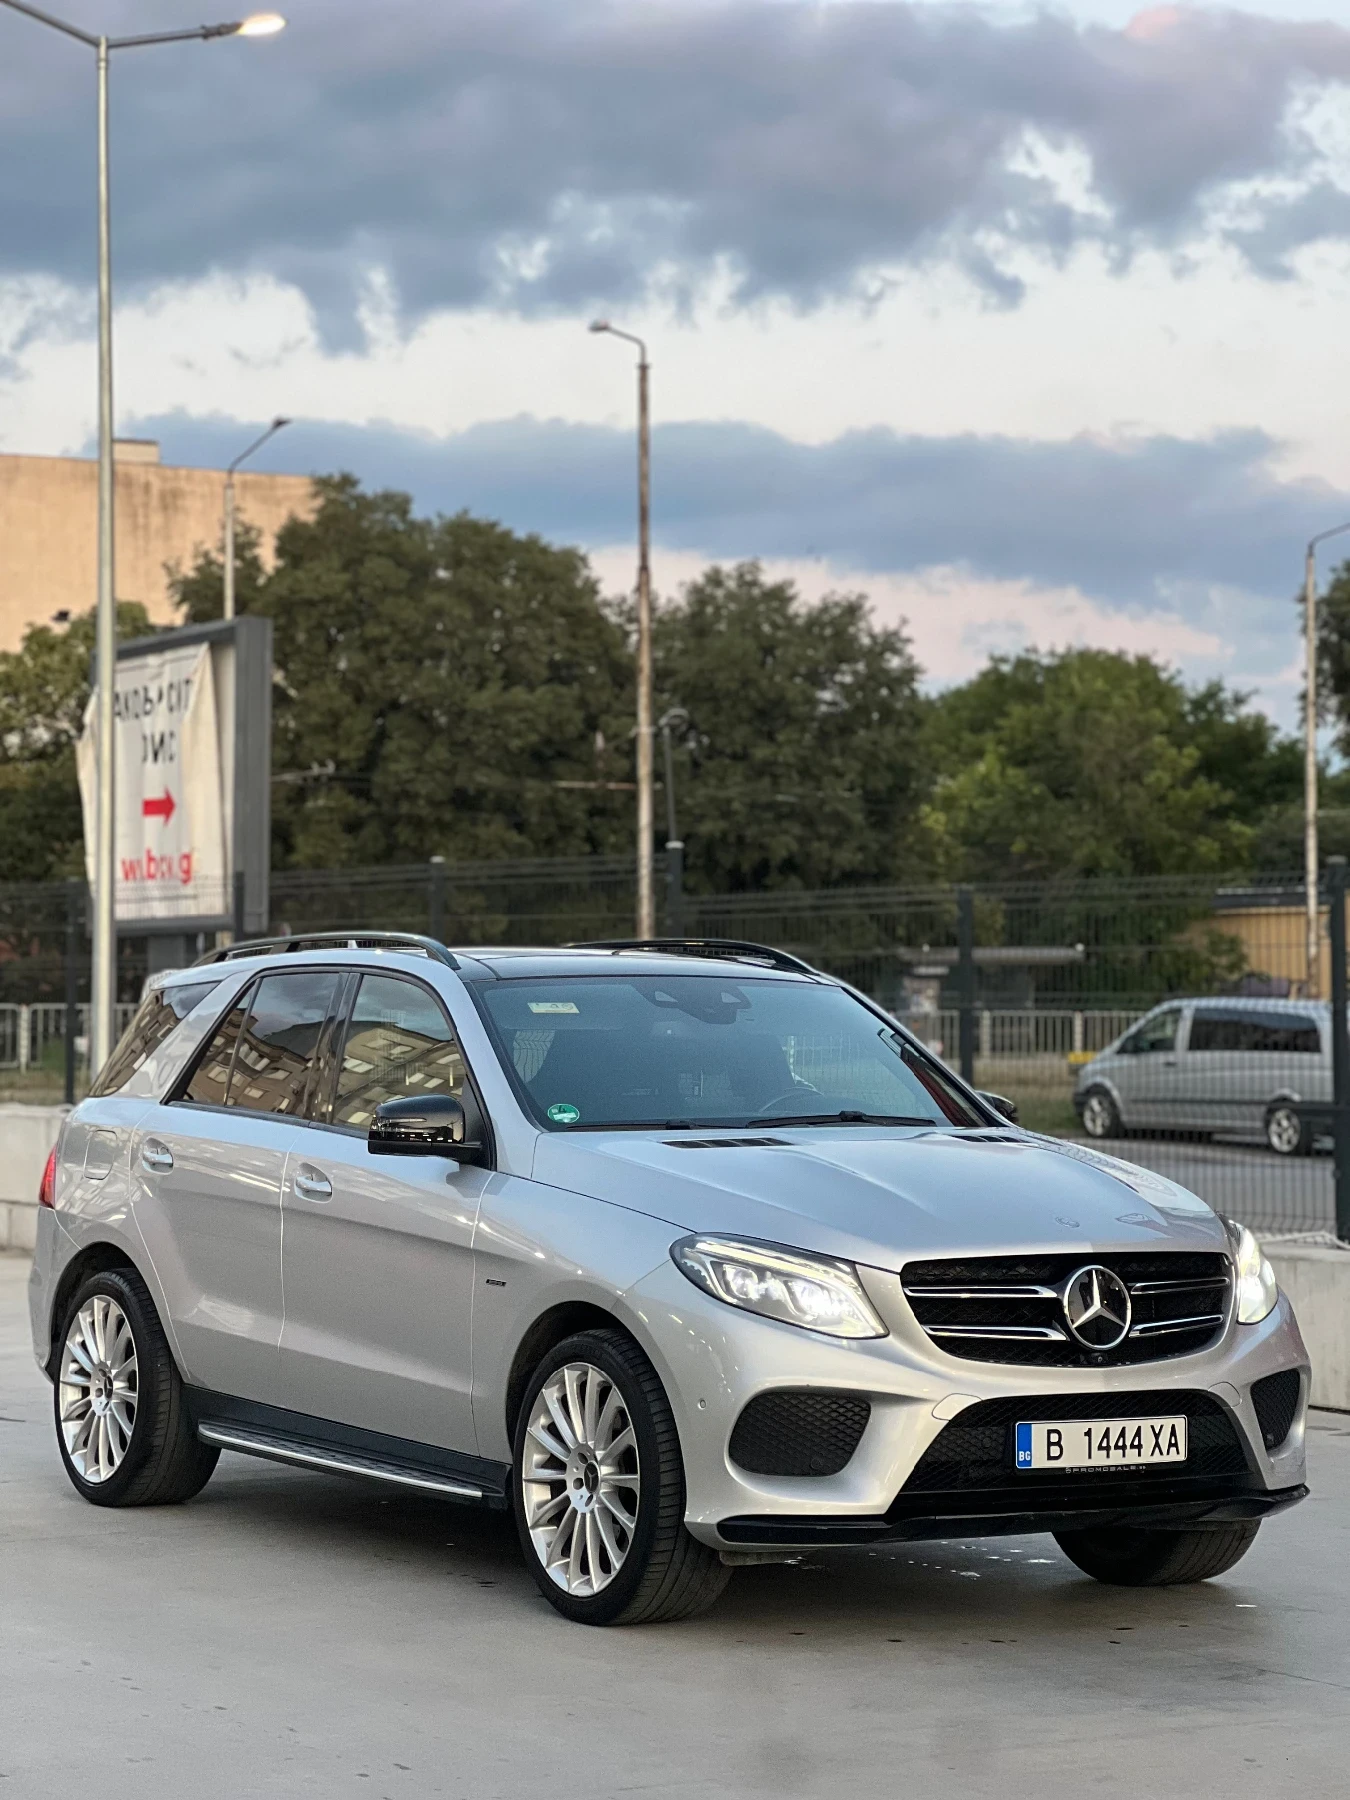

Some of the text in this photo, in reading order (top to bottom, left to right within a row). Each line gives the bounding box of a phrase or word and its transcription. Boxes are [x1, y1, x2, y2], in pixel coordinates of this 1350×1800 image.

[1046, 1423, 1180, 1461] B 1444 XA
[1018, 1451, 1031, 1461] BG
